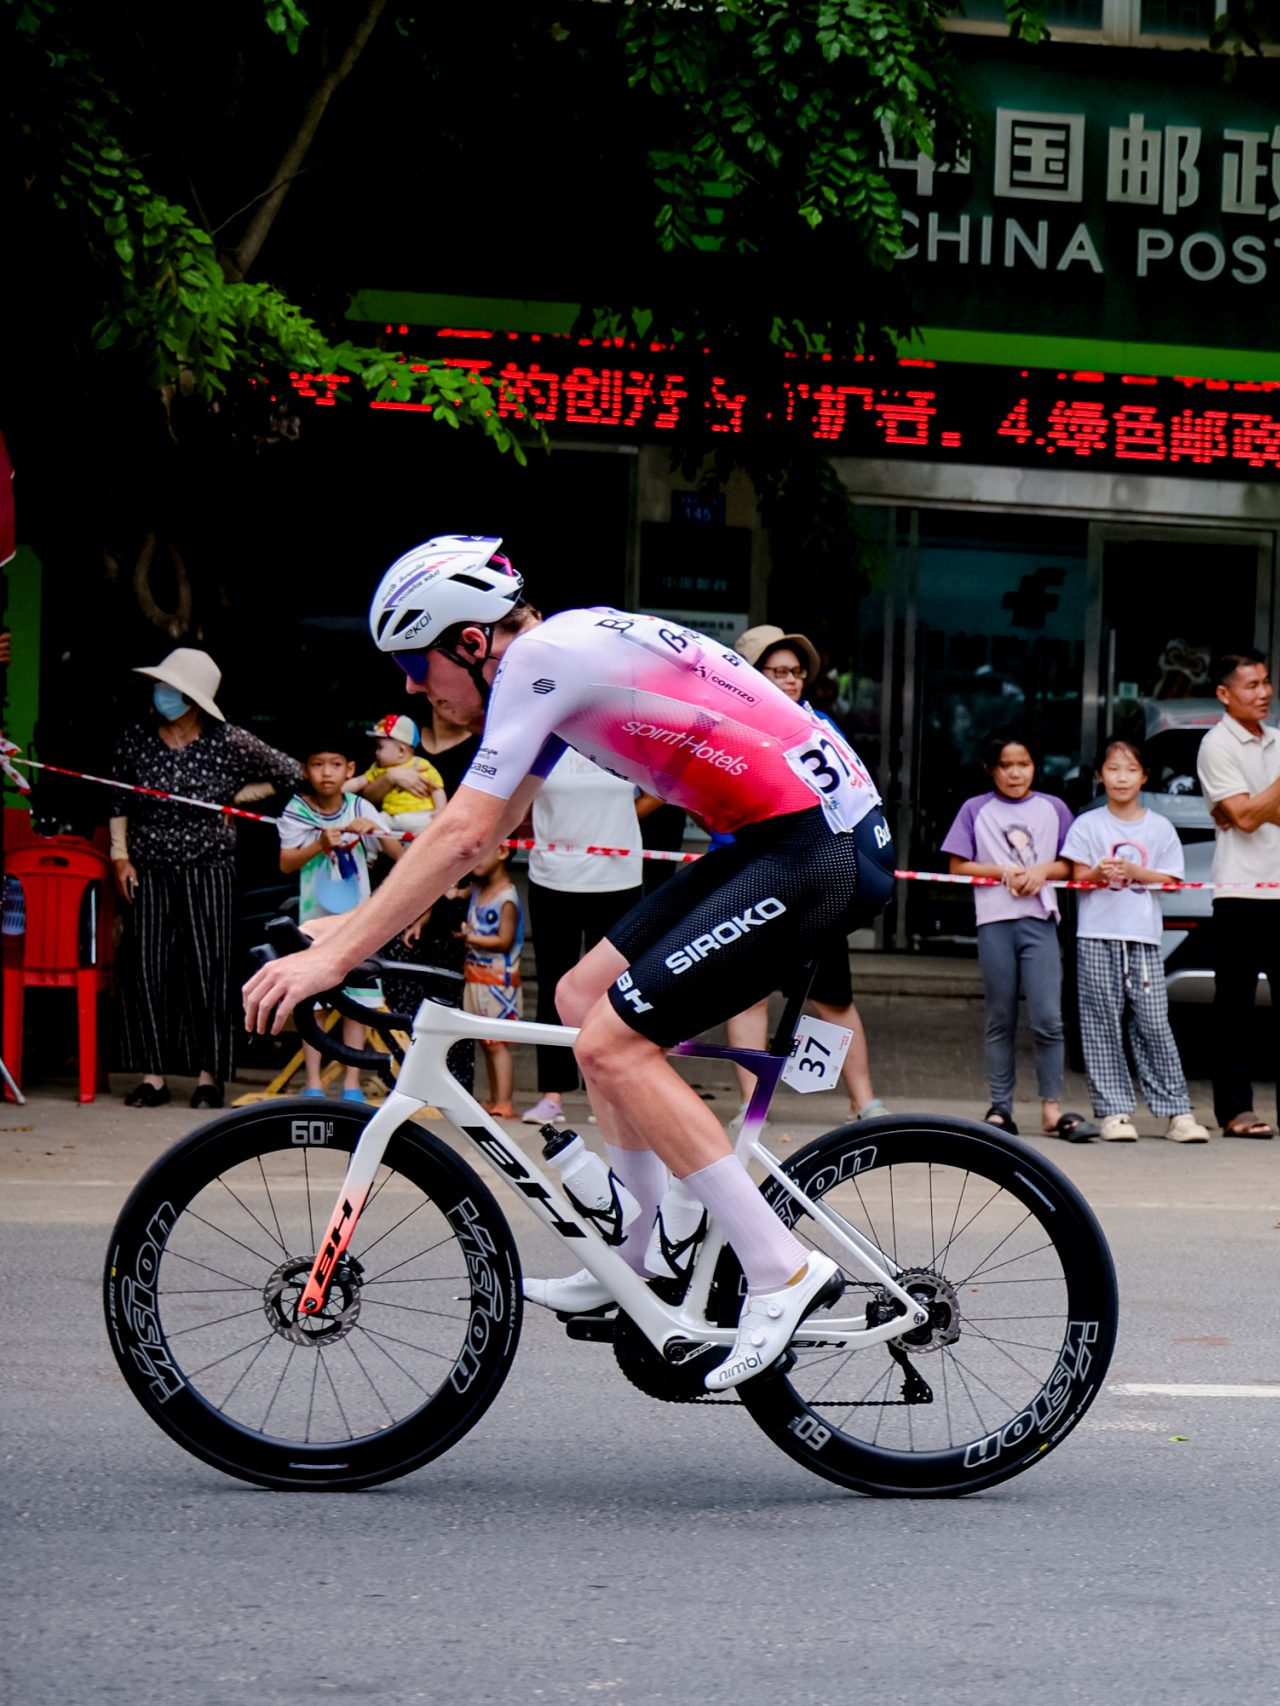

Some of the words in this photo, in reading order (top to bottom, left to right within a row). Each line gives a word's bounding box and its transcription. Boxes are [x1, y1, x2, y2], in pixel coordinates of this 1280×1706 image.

[711, 675, 755, 703] CORTIZO
[665, 897, 787, 975] SIROKO
[616, 970, 654, 1014] BH
[798, 1036, 832, 1078] 37
[292, 1120, 325, 1145] 60
[461, 1126, 587, 1239] BH
[314, 1198, 353, 1289] BH
[121, 1201, 186, 1404] Vision
[446, 1197, 504, 1394] Vision
[718, 1352, 763, 1382] nimbl
[963, 1321, 1100, 1468] Vision
[793, 1414, 832, 1451] 60
